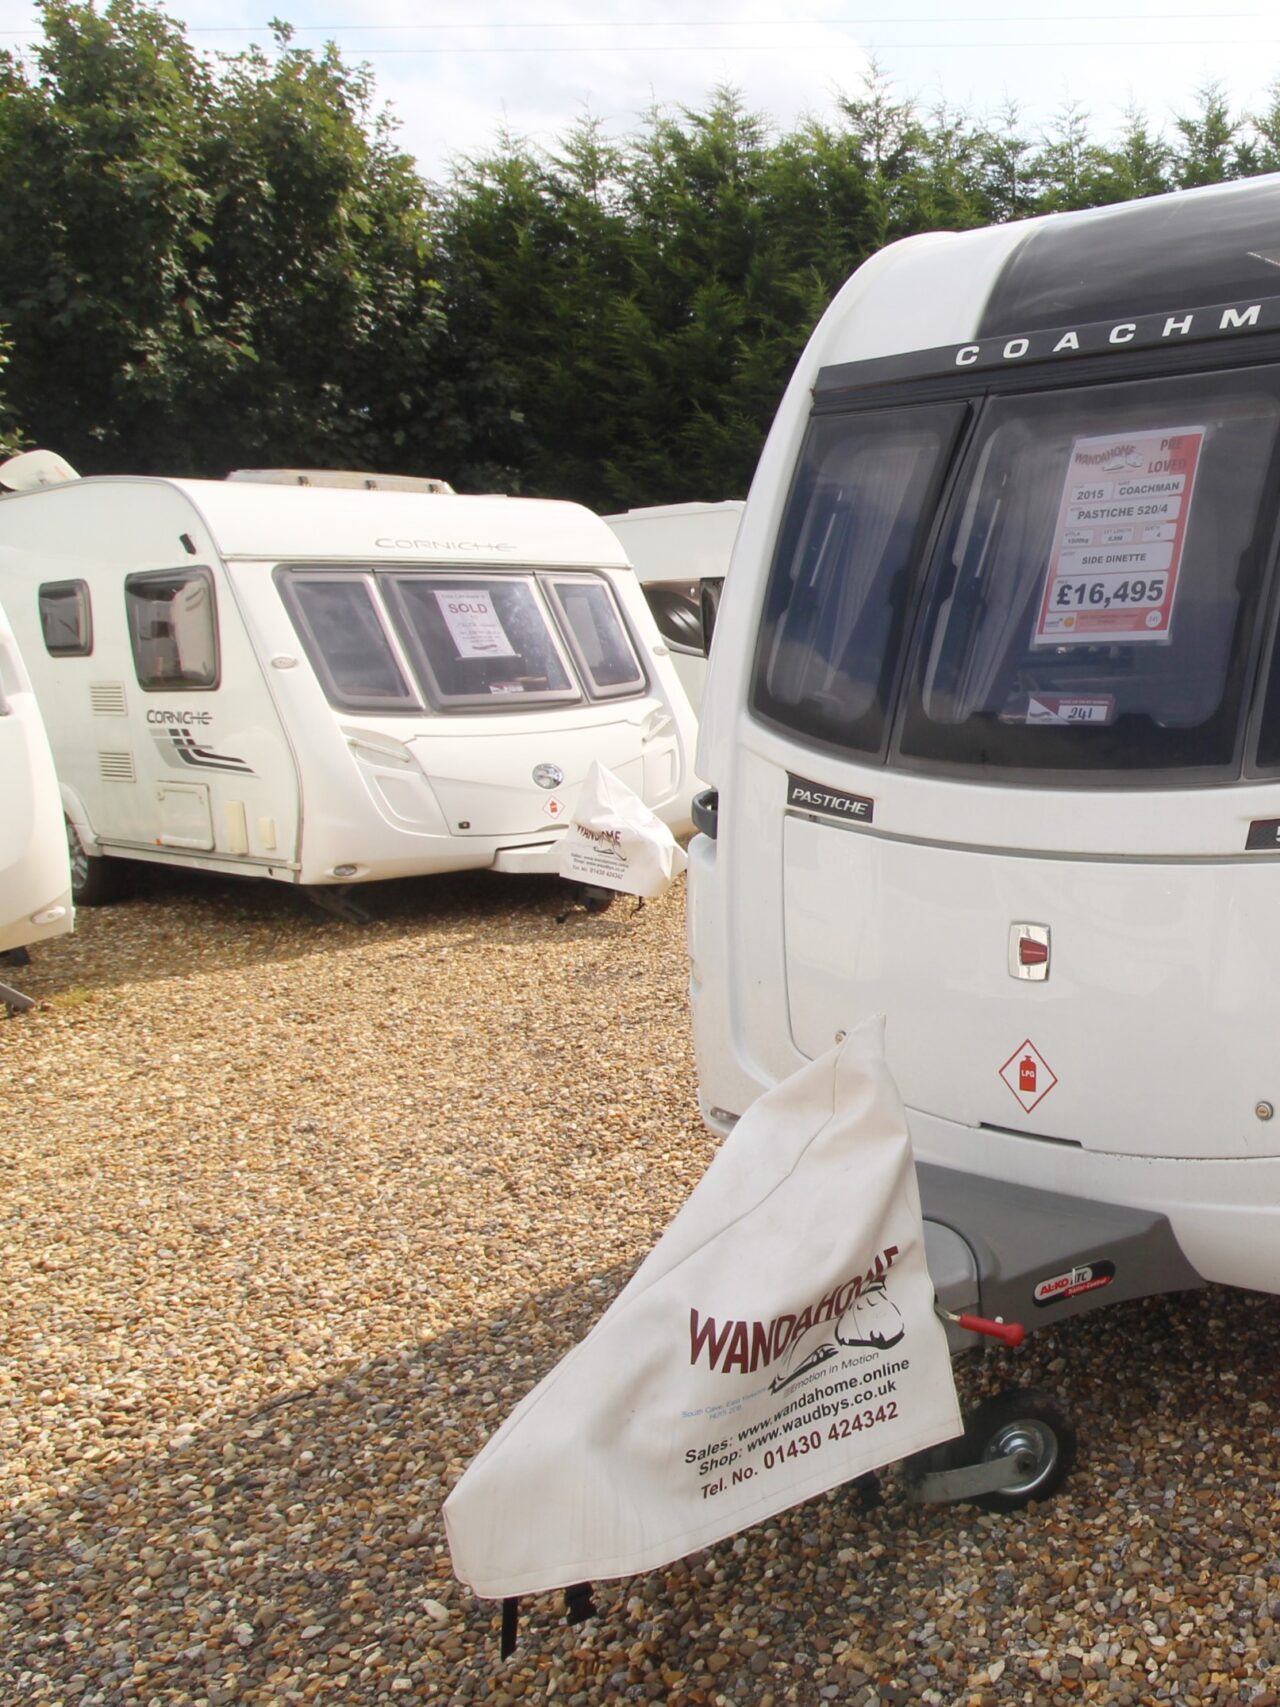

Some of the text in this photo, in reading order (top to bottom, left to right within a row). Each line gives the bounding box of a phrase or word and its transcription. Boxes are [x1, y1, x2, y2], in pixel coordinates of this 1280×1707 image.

[1075, 445, 1137, 466] WANDAHOME
[1147, 458, 1187, 474] LOVED
[1077, 489, 1104, 501] 2015
[1118, 481, 1180, 496] COACHMAN
[1077, 503, 1169, 520] PASTICHE 520/4
[374, 537, 518, 552] CORNICHE
[1081, 552, 1147, 565] SIDE DINETTE
[1056, 578, 1164, 608] £16,495
[447, 602, 489, 614] SOLD
[146, 708, 214, 725] CORNICHE
[1068, 706, 1094, 720] 241
[791, 787, 869, 816] PASTICHE
[1020, 1069, 1035, 1079] LPG
[829, 1364, 839, 1375] in
[841, 1351, 879, 1371] Motion
[684, 1358, 910, 1464] Sales: www.wandahome.online
[698, 1380, 897, 1477] Shop: www.waudbys.co.uk
[700, 1401, 898, 1499] Tel. No. 01430 424342
